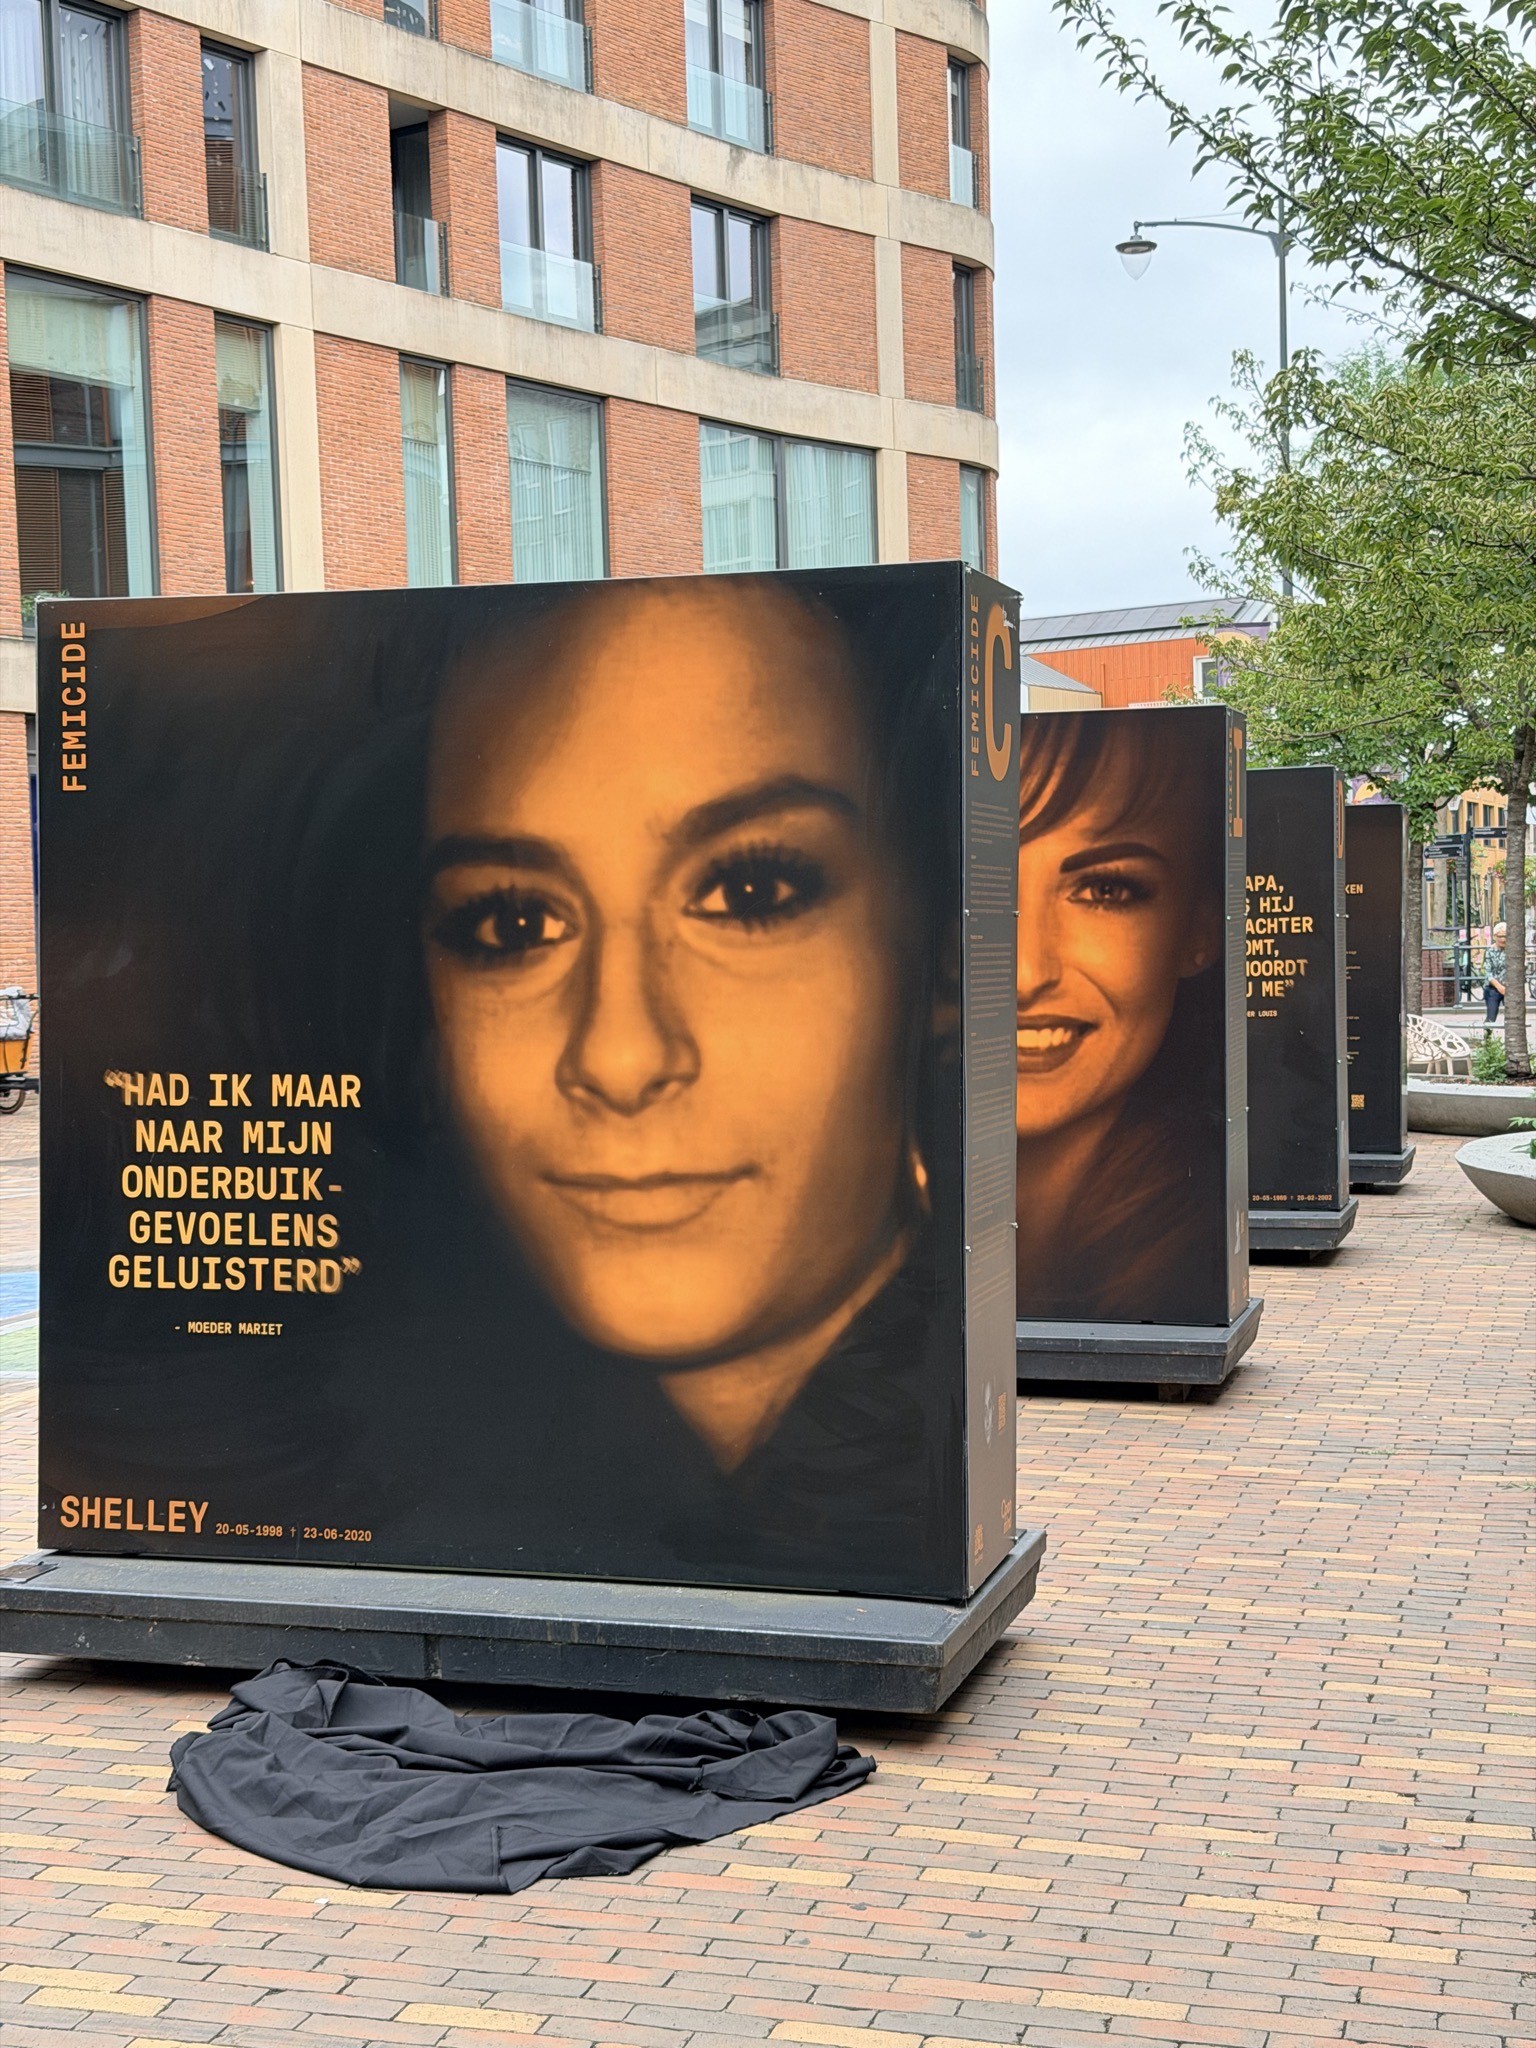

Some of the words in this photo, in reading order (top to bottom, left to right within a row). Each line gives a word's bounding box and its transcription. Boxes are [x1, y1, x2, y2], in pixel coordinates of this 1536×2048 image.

[970, 594, 979, 777] FEMICIDE
[984, 602, 1012, 781] C
[61, 621, 87, 792] FEMICIDE
[1259, 896, 1294, 914] HIJ
[209, 1073, 252, 1107] IK
[271, 1073, 361, 1108] MAAR
[135, 1119, 223, 1154] NAAR
[243, 1120, 332, 1155] MIJN
[121, 1164, 342, 1201] ONDERBUIK-
[129, 1210, 339, 1248] GEVOELENS
[187, 1321, 232, 1335] MOEDER
[238, 1322, 283, 1336] MARIET
[60, 1495, 209, 1533] SHELLEY
[215, 1523, 283, 1537] 20-05-1998
[303, 1527, 372, 1542] 23-06-2020
